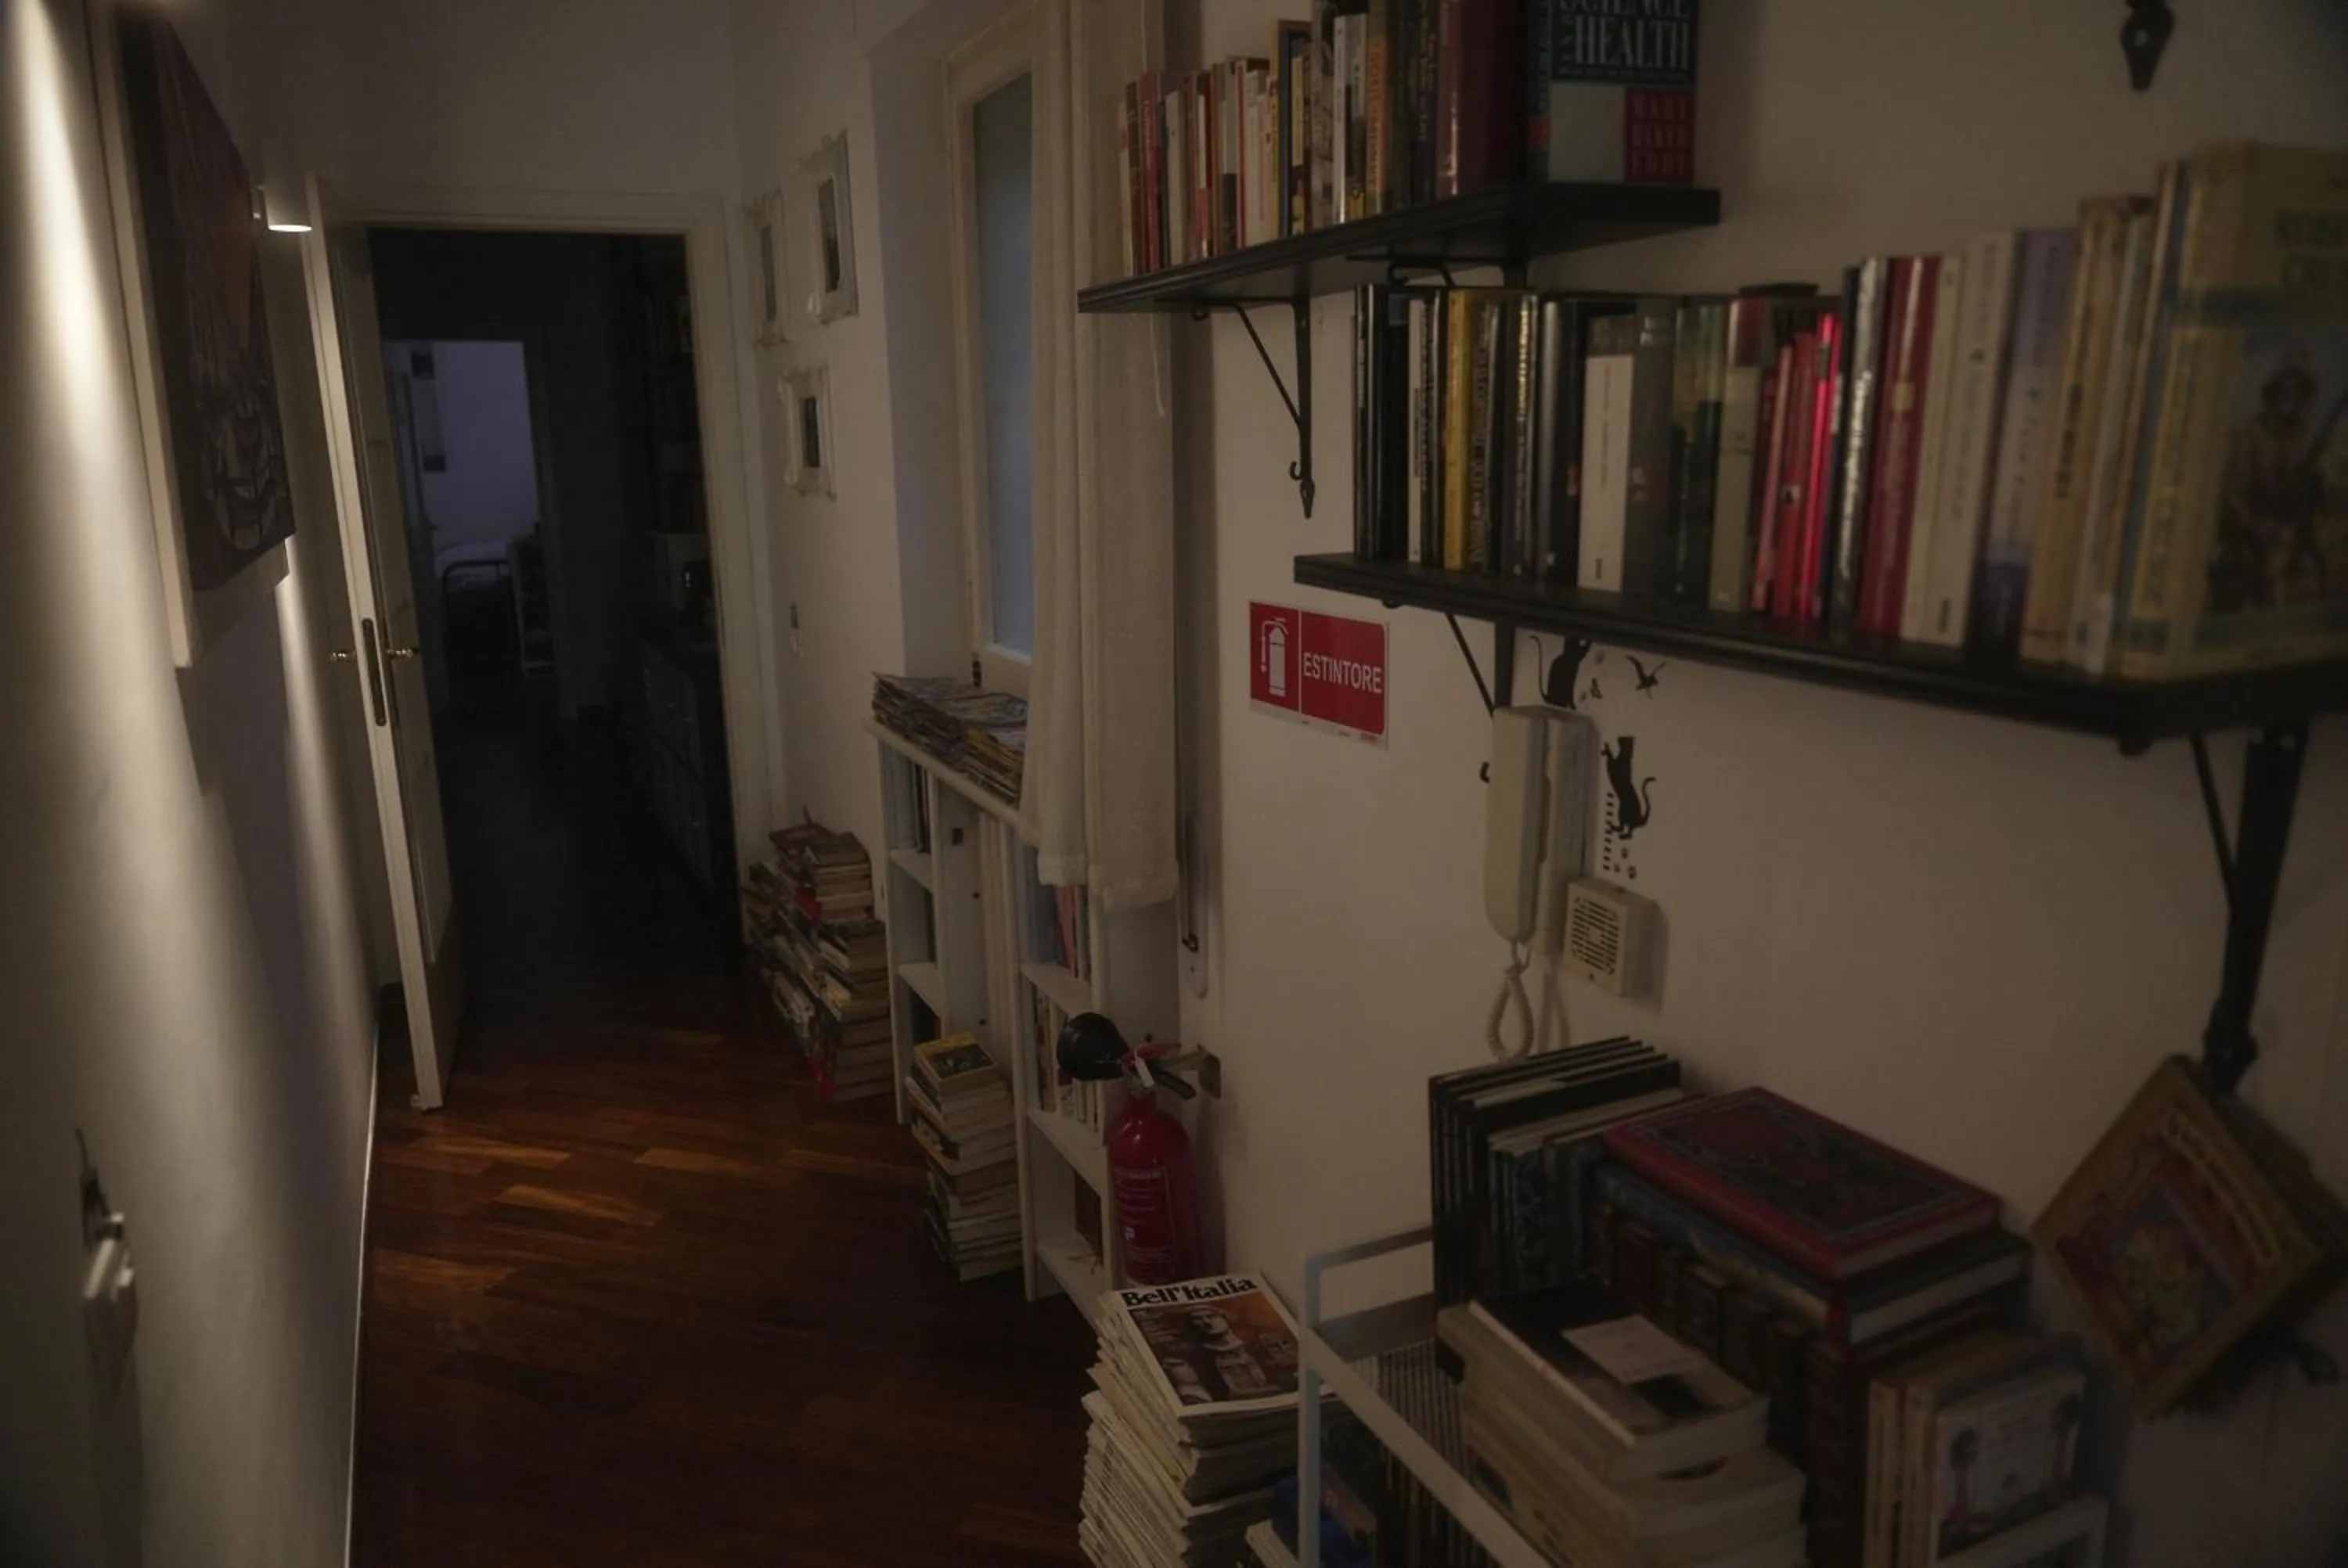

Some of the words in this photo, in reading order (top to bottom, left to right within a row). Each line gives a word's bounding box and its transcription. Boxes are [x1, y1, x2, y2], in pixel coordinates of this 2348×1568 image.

[1575, 15, 1689, 70] HEALTH
[1303, 651, 1383, 695] ESTINTORE
[1121, 1277, 1258, 1307] Bell'Italia
